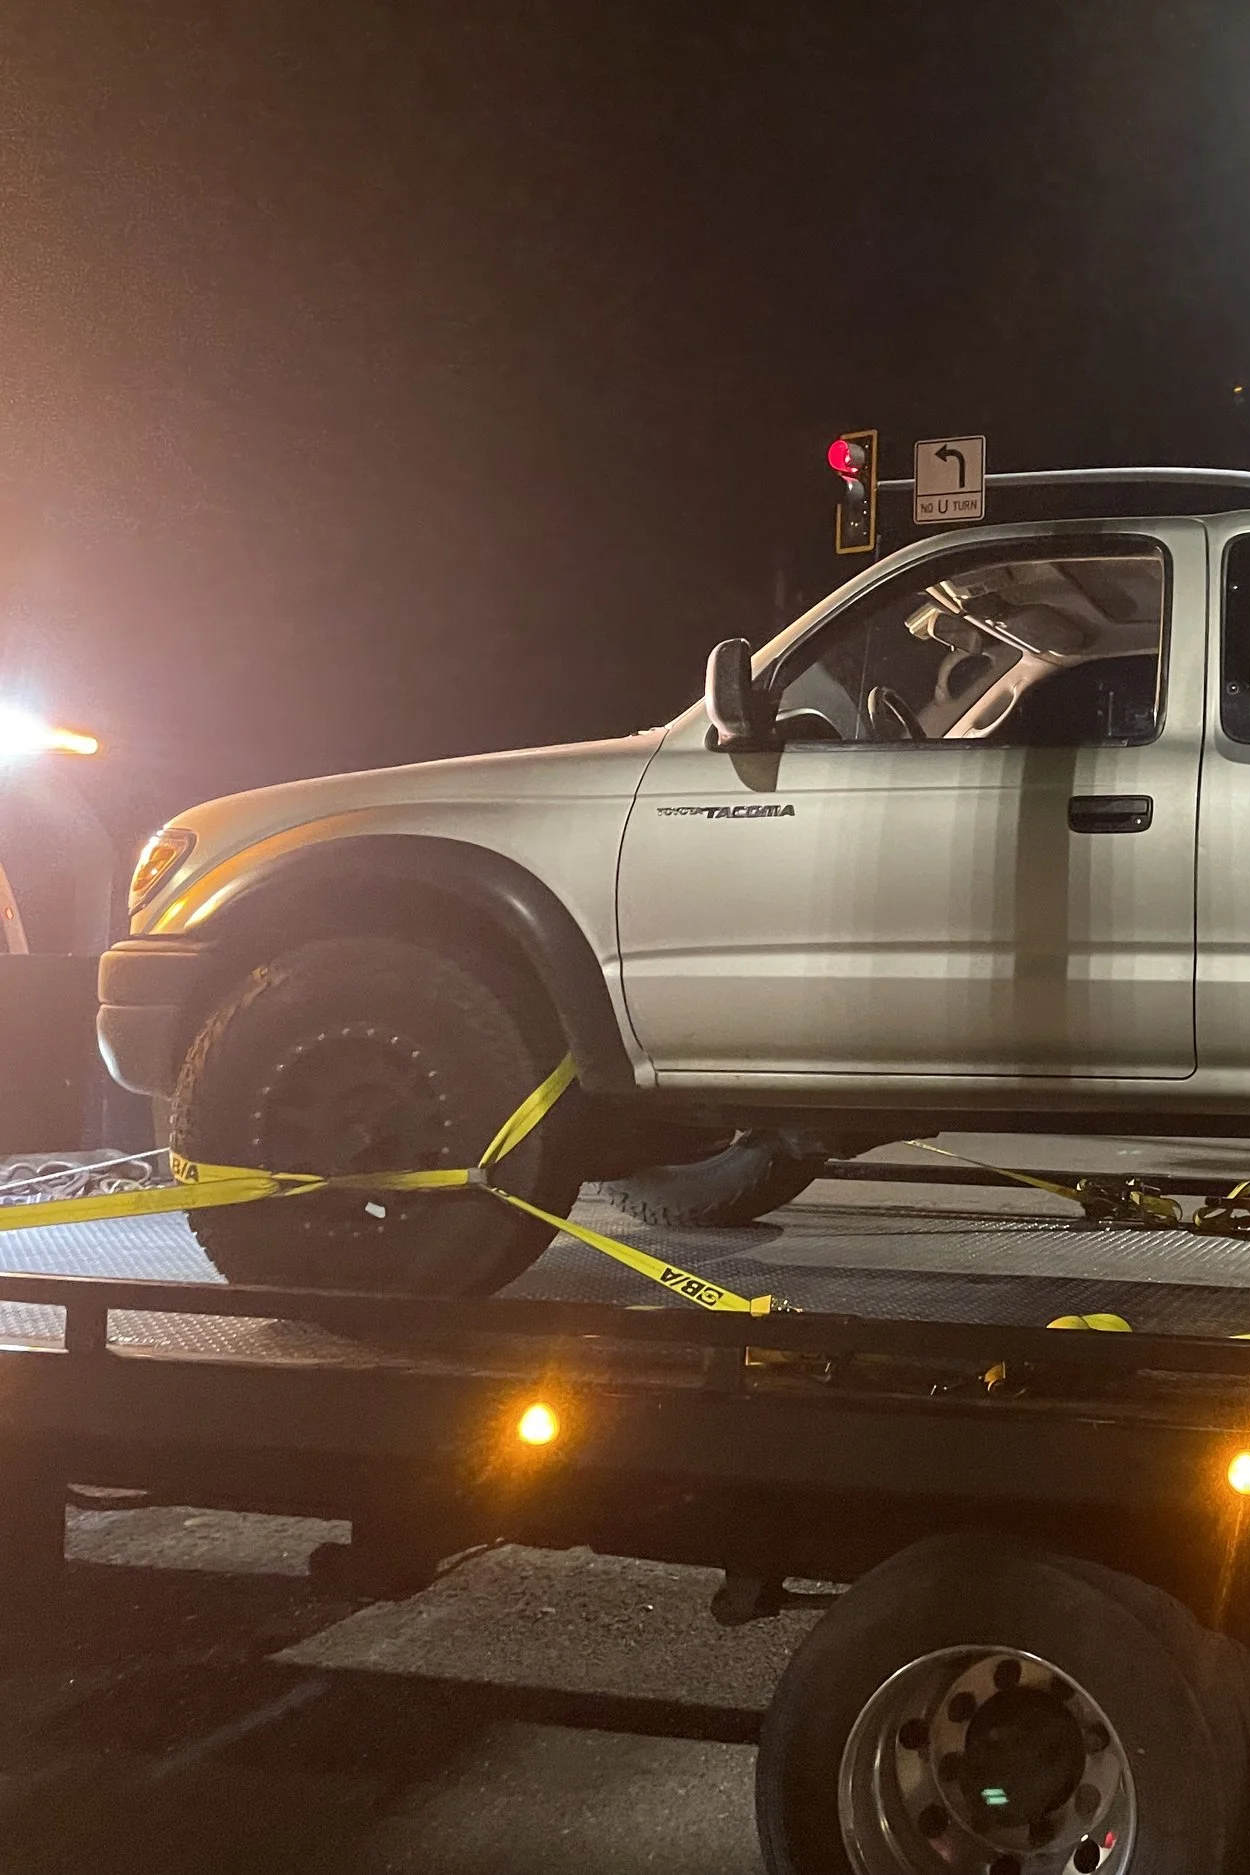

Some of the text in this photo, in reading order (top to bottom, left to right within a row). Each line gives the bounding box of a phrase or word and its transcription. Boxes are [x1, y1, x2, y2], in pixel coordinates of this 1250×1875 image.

[920, 499, 978, 514] NO U TURN
[703, 804, 796, 819] TACOMA
